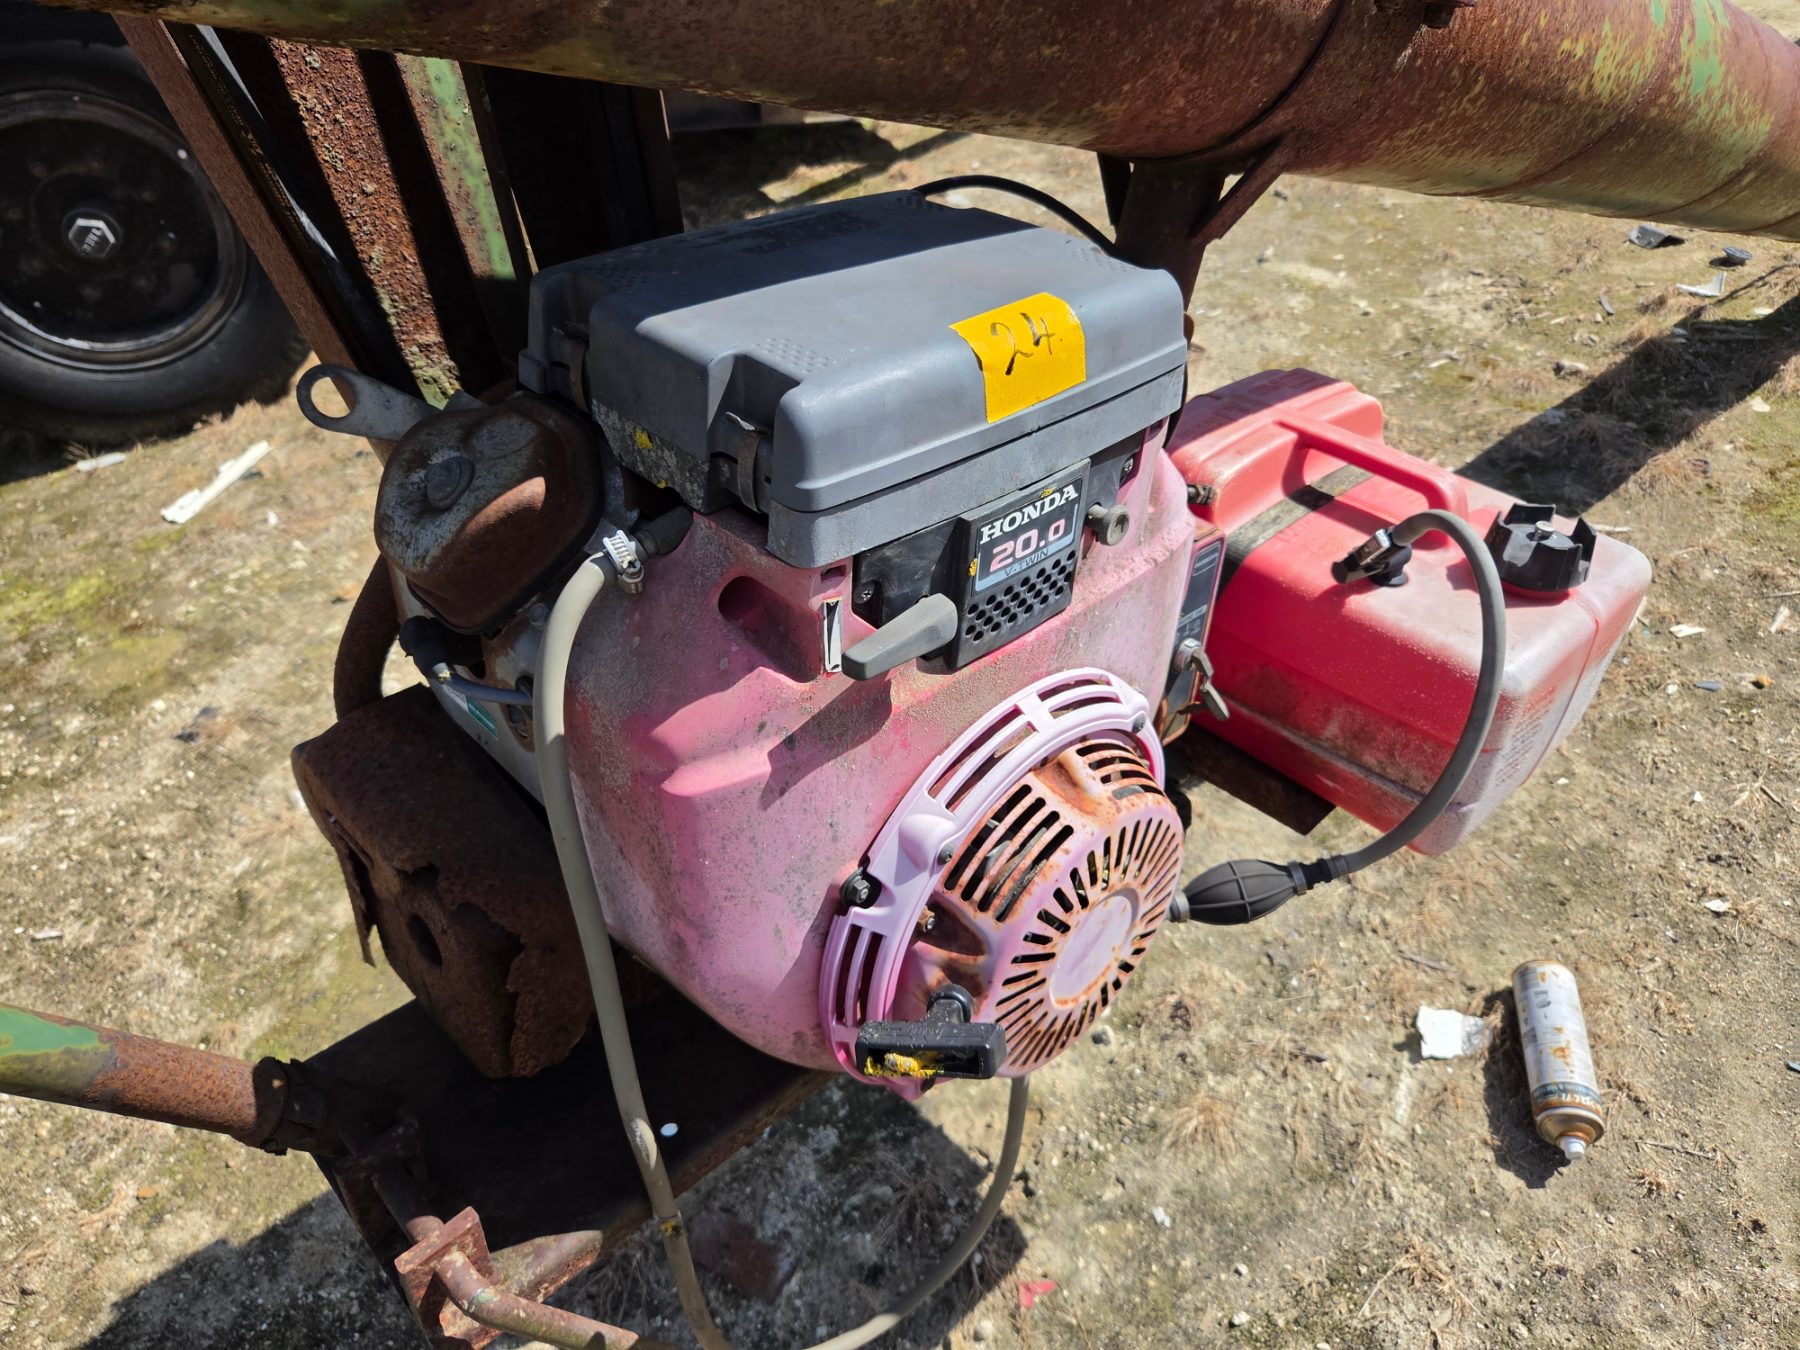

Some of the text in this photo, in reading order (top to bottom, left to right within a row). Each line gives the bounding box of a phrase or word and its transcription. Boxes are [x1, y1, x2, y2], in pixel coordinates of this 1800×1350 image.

[990, 312, 1055, 376] 24
[980, 484, 1079, 545] HONDA
[989, 518, 1066, 573] 20.0
[1004, 548, 1049, 577] V-TWIN
